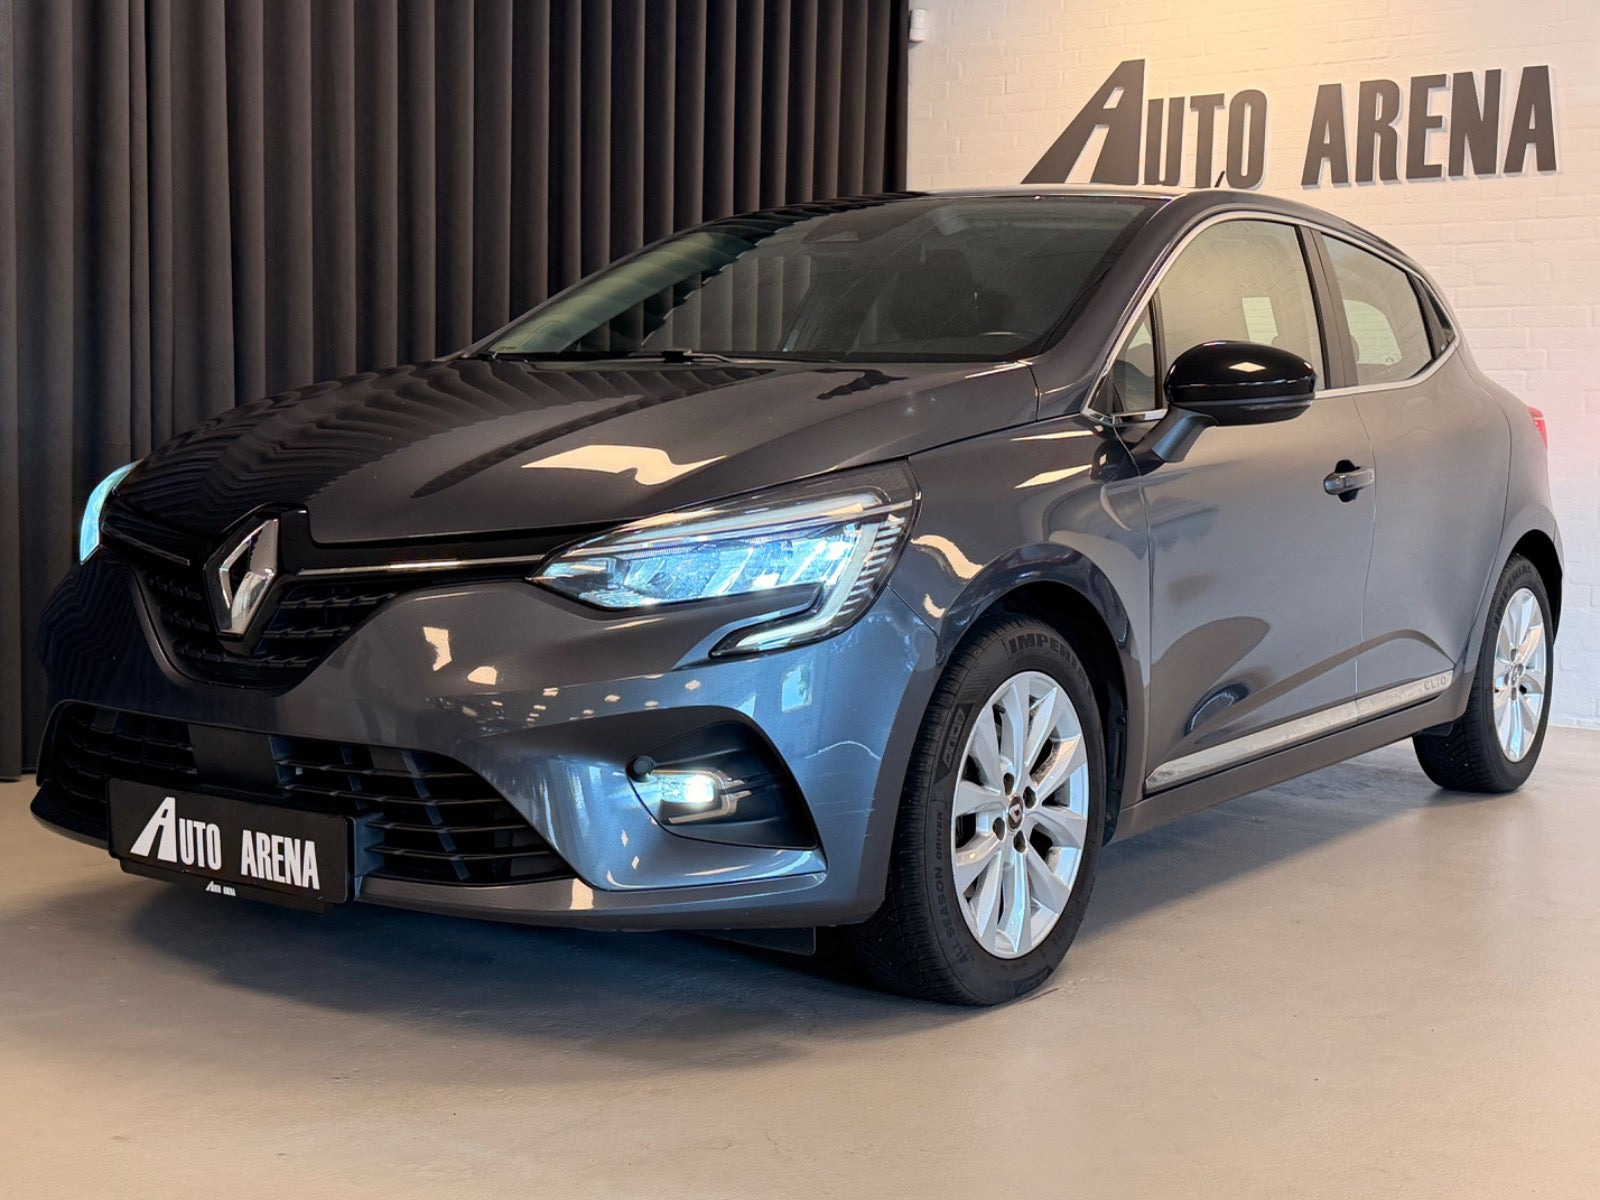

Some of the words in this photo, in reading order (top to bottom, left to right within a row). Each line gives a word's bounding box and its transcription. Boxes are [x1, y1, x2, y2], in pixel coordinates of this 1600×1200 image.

[1021, 58, 1268, 189] AUTO
[1300, 64, 1557, 187] ARENA
[130, 796, 222, 871] AUTO
[241, 829, 320, 890] ARENA
[934, 811, 944, 860] DRIVER
[934, 867, 956, 938] SEASON
